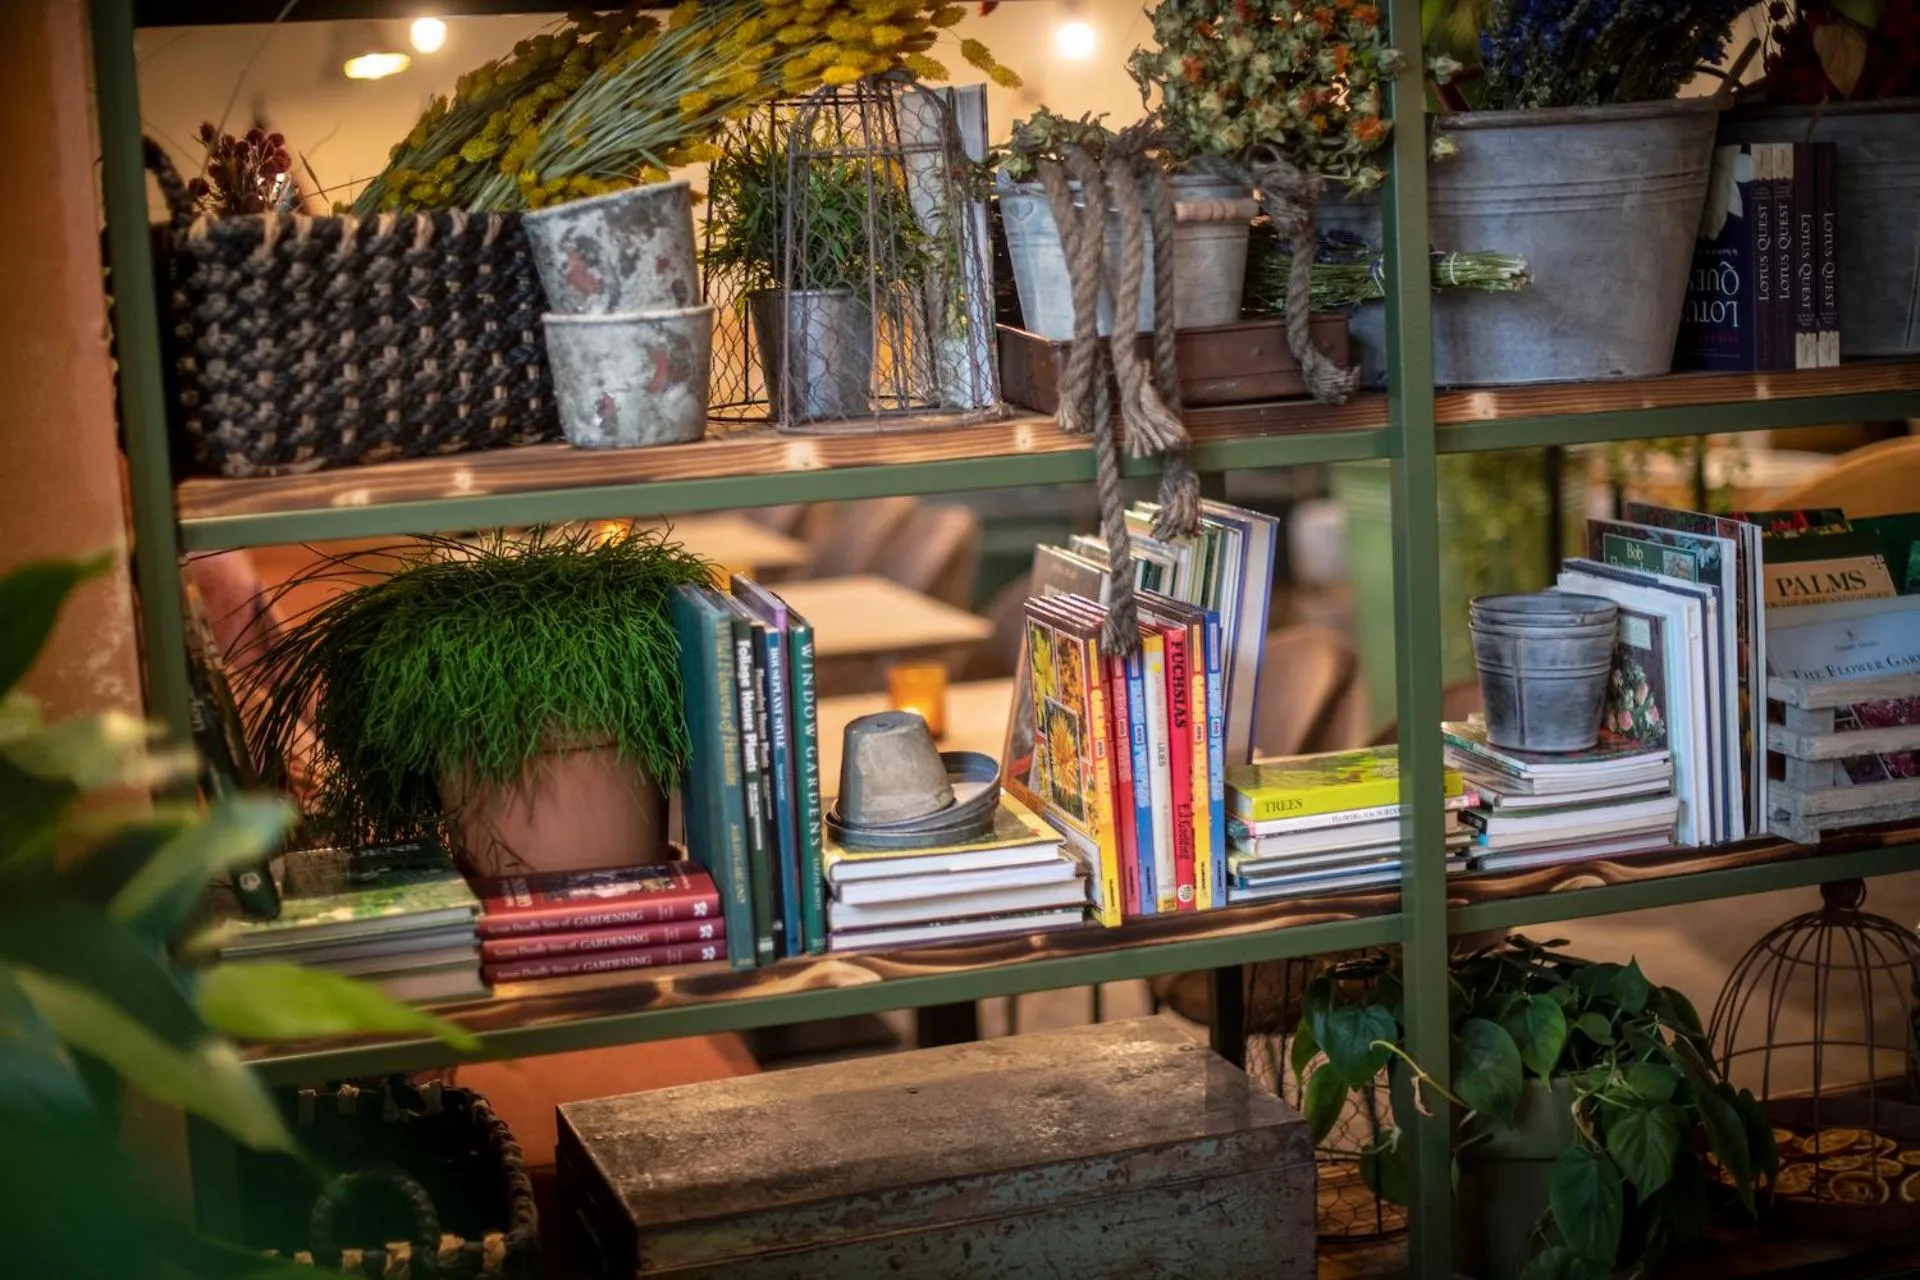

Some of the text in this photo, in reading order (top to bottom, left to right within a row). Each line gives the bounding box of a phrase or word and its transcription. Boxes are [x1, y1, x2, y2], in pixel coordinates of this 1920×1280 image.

[1757, 204, 1771, 251] QUEST
[1778, 203, 1791, 250] QUEST
[1801, 214, 1812, 259] LOTUS
[1823, 213, 1834, 257] LOTUS
[1688, 261, 1739, 295] QUE
[1758, 255, 1769, 300] LOTUS
[1779, 254, 1790, 299] LOTUS
[1799, 263, 1813, 309] QUEST
[1821, 262, 1835, 307] QUEST
[1686, 301, 1739, 327] LOTU
[1625, 542, 1644, 561] Bob
[1774, 570, 1867, 597] PALMS
[735, 639, 754, 687] Foliage
[1171, 640, 1186, 728] FUCHSIAS
[1789, 668, 1820, 680] THE
[1825, 661, 1885, 678] FLOWER
[740, 690, 756, 730] House
[743, 732, 759, 772] Plants
[800, 643, 821, 845] WINDOW GARDENS
[1264, 798, 1303, 813] TREES
[574, 910, 643, 925] GARDENING
[580, 933, 648, 948] GARDENING
[583, 955, 652, 970] GARDENING
